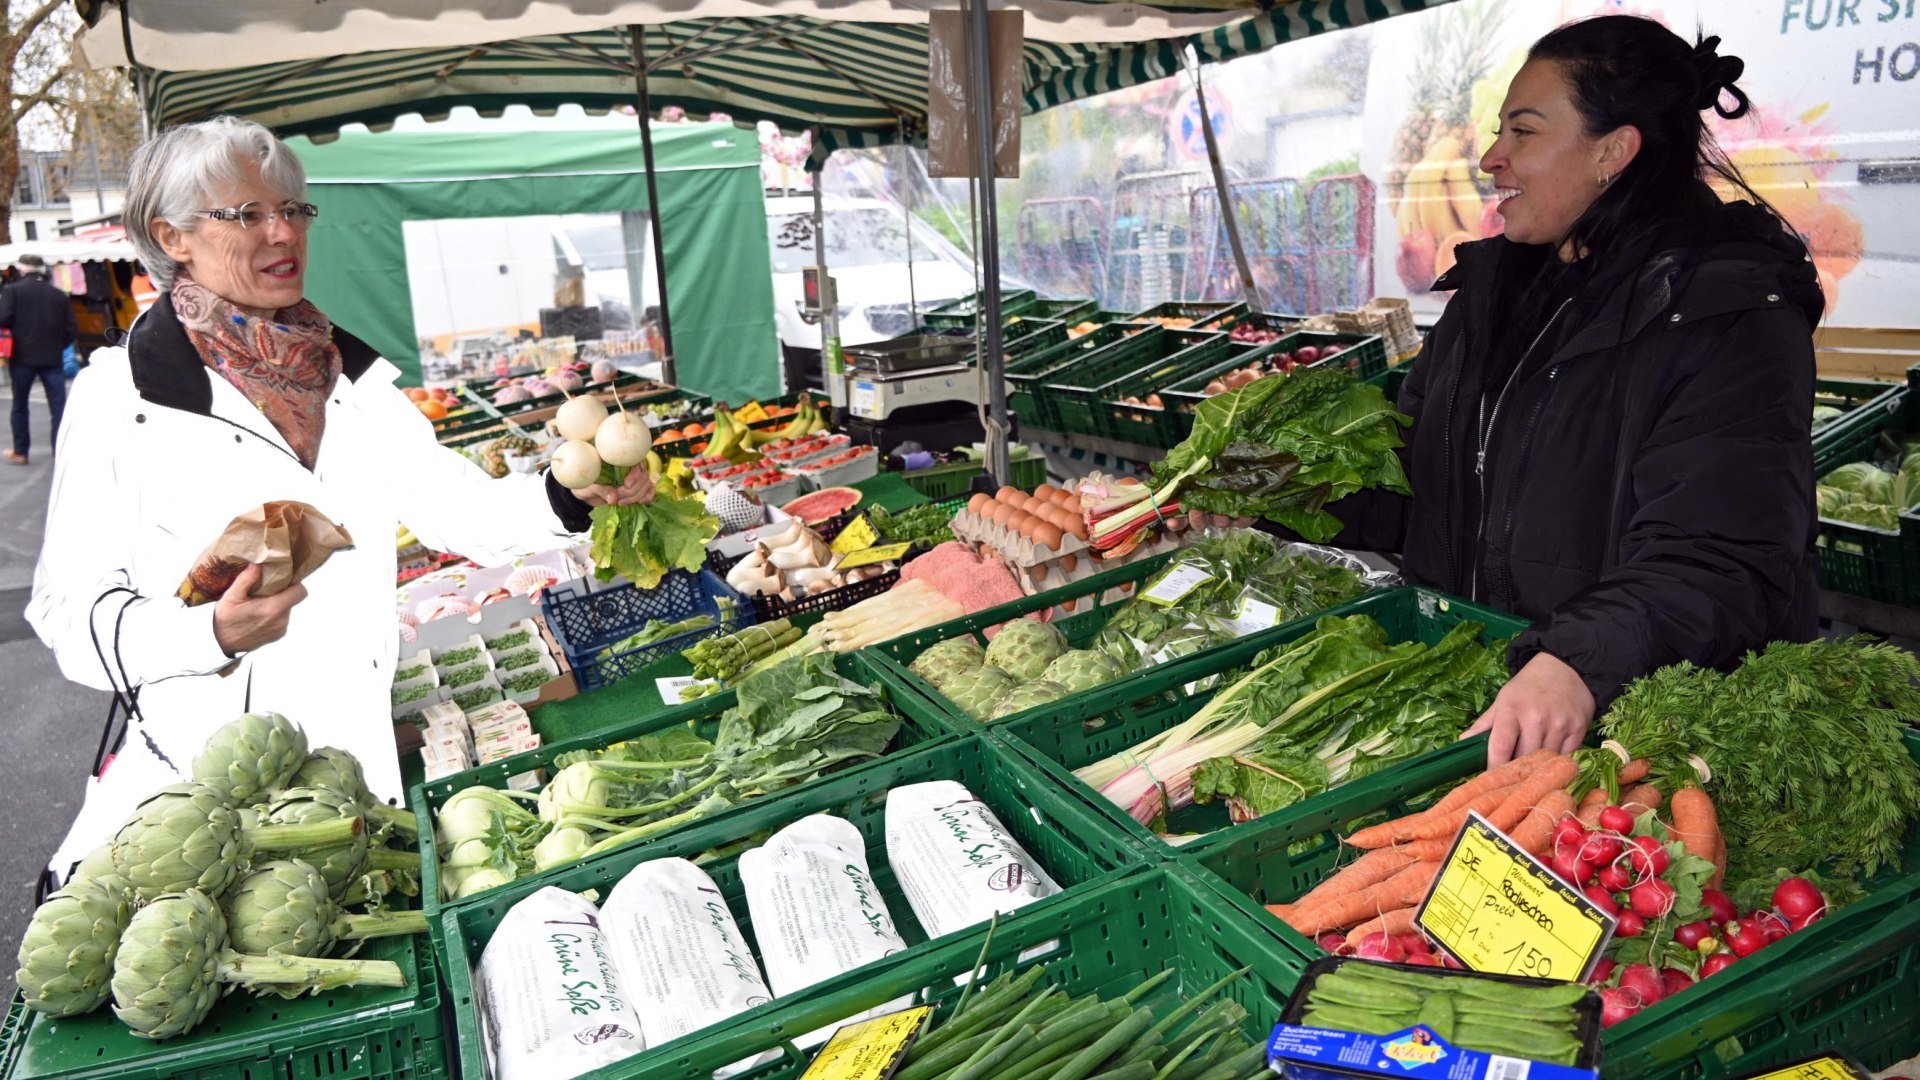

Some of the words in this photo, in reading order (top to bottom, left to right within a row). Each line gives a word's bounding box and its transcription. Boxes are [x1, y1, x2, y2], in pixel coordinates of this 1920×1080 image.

[1852, 42, 1920, 85] HO
[1461, 847, 1482, 872] DE
[1510, 867, 1544, 898] Warenart
[1482, 894, 1516, 918] Preis
[547, 933, 582, 976] Grüne
[556, 980, 601, 1015] Soße
[1282, 1026, 1346, 1039] Zuckererbsen
